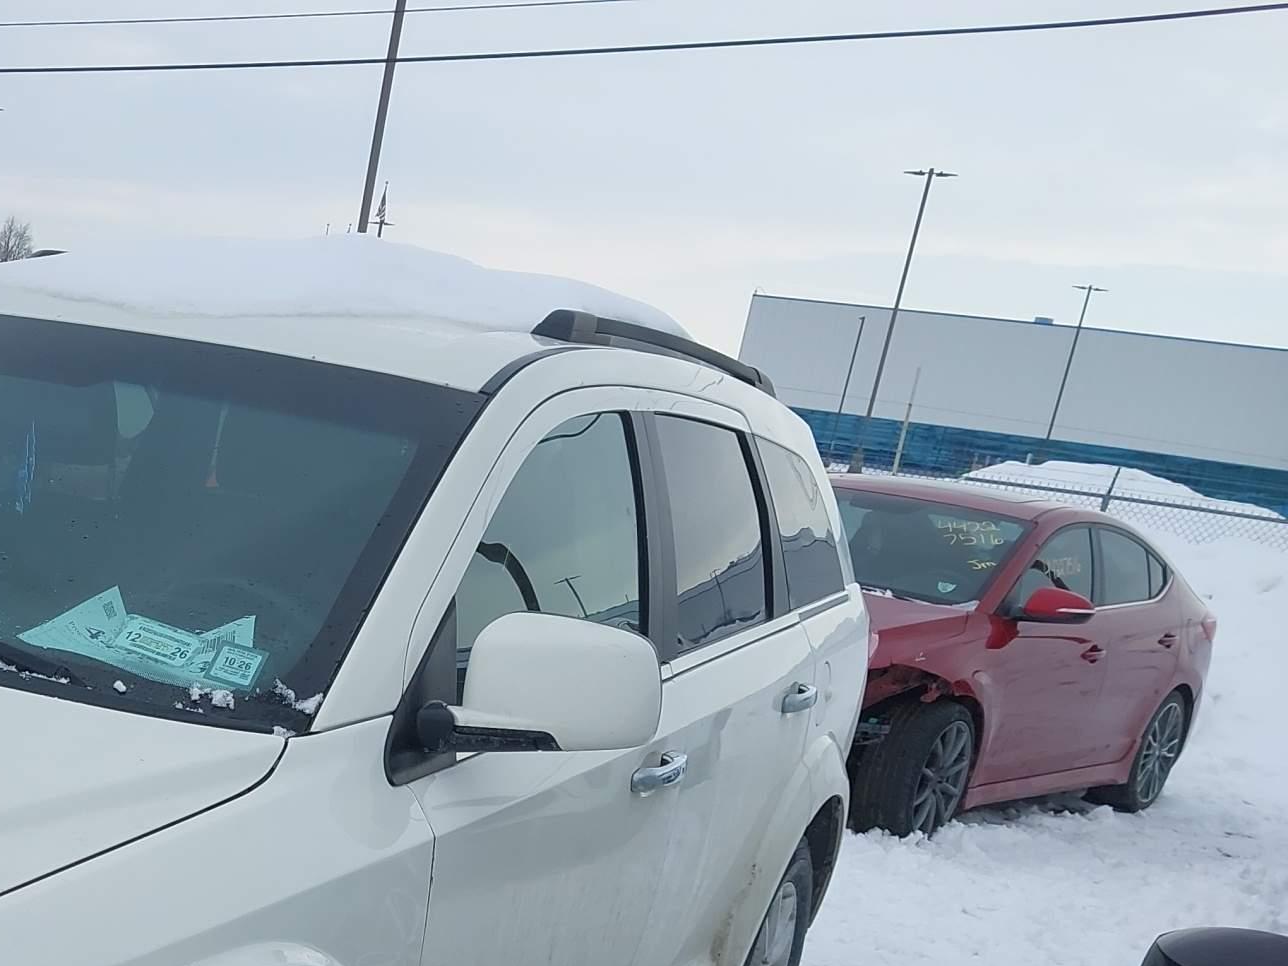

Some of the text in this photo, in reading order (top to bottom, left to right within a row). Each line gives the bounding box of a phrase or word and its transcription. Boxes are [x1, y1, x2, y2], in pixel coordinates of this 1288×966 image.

[937, 520, 1001, 533] 4422
[943, 533, 1005, 546] 7516
[125, 630, 142, 643] 12
[170, 646, 190, 660] 26
